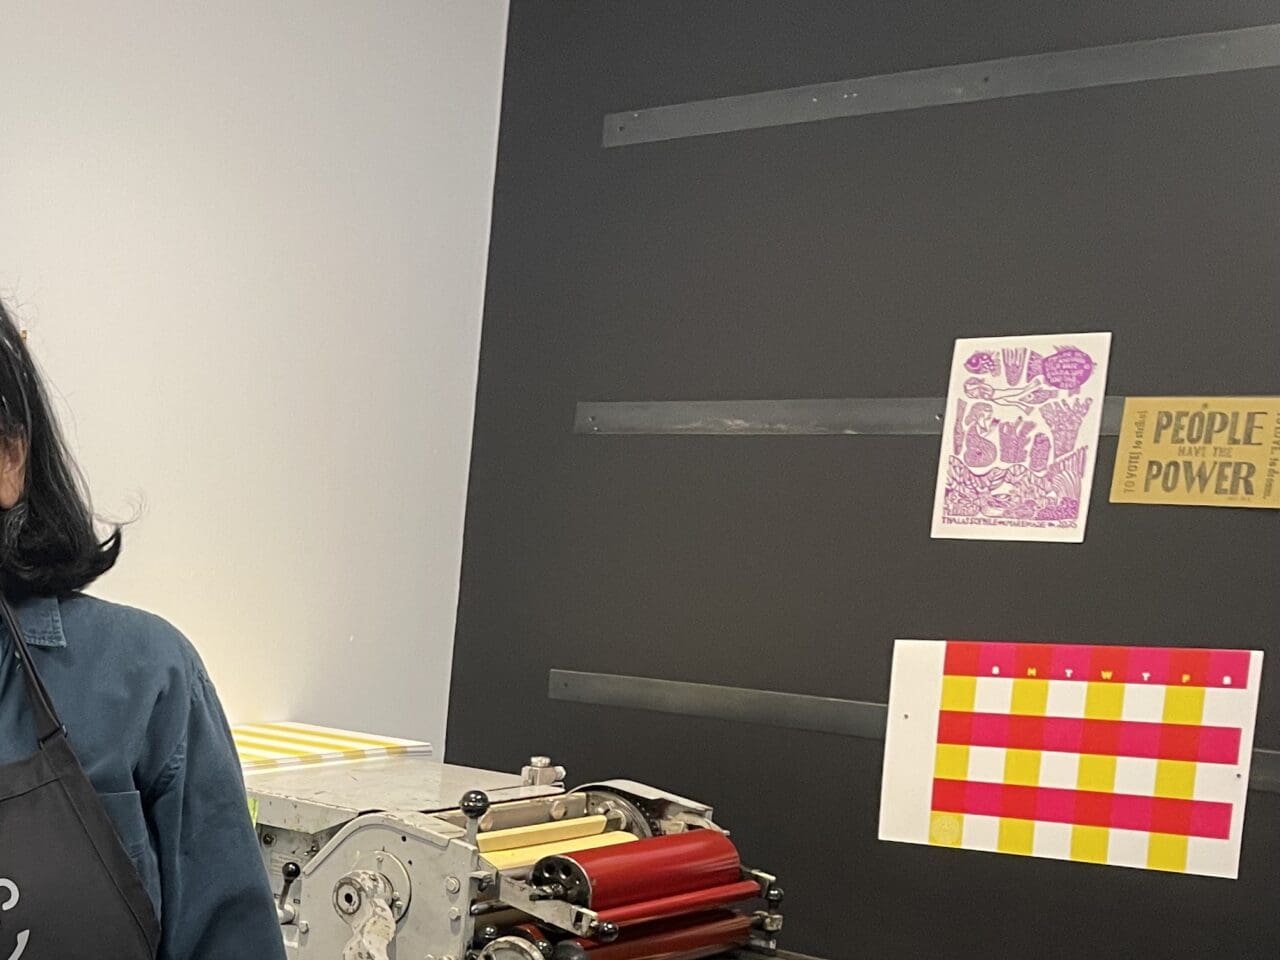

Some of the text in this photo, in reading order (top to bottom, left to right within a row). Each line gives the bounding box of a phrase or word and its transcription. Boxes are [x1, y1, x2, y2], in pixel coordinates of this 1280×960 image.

[1153, 410, 1268, 446] PEOPLE
[1178, 446, 1233, 458] HAVE THE
[1144, 460, 1256, 496] POWER
[1027, 667, 1037, 677] M
[1065, 668, 1073, 678] T
[1101, 671, 1113, 680] W
[1142, 672, 1151, 681] T
